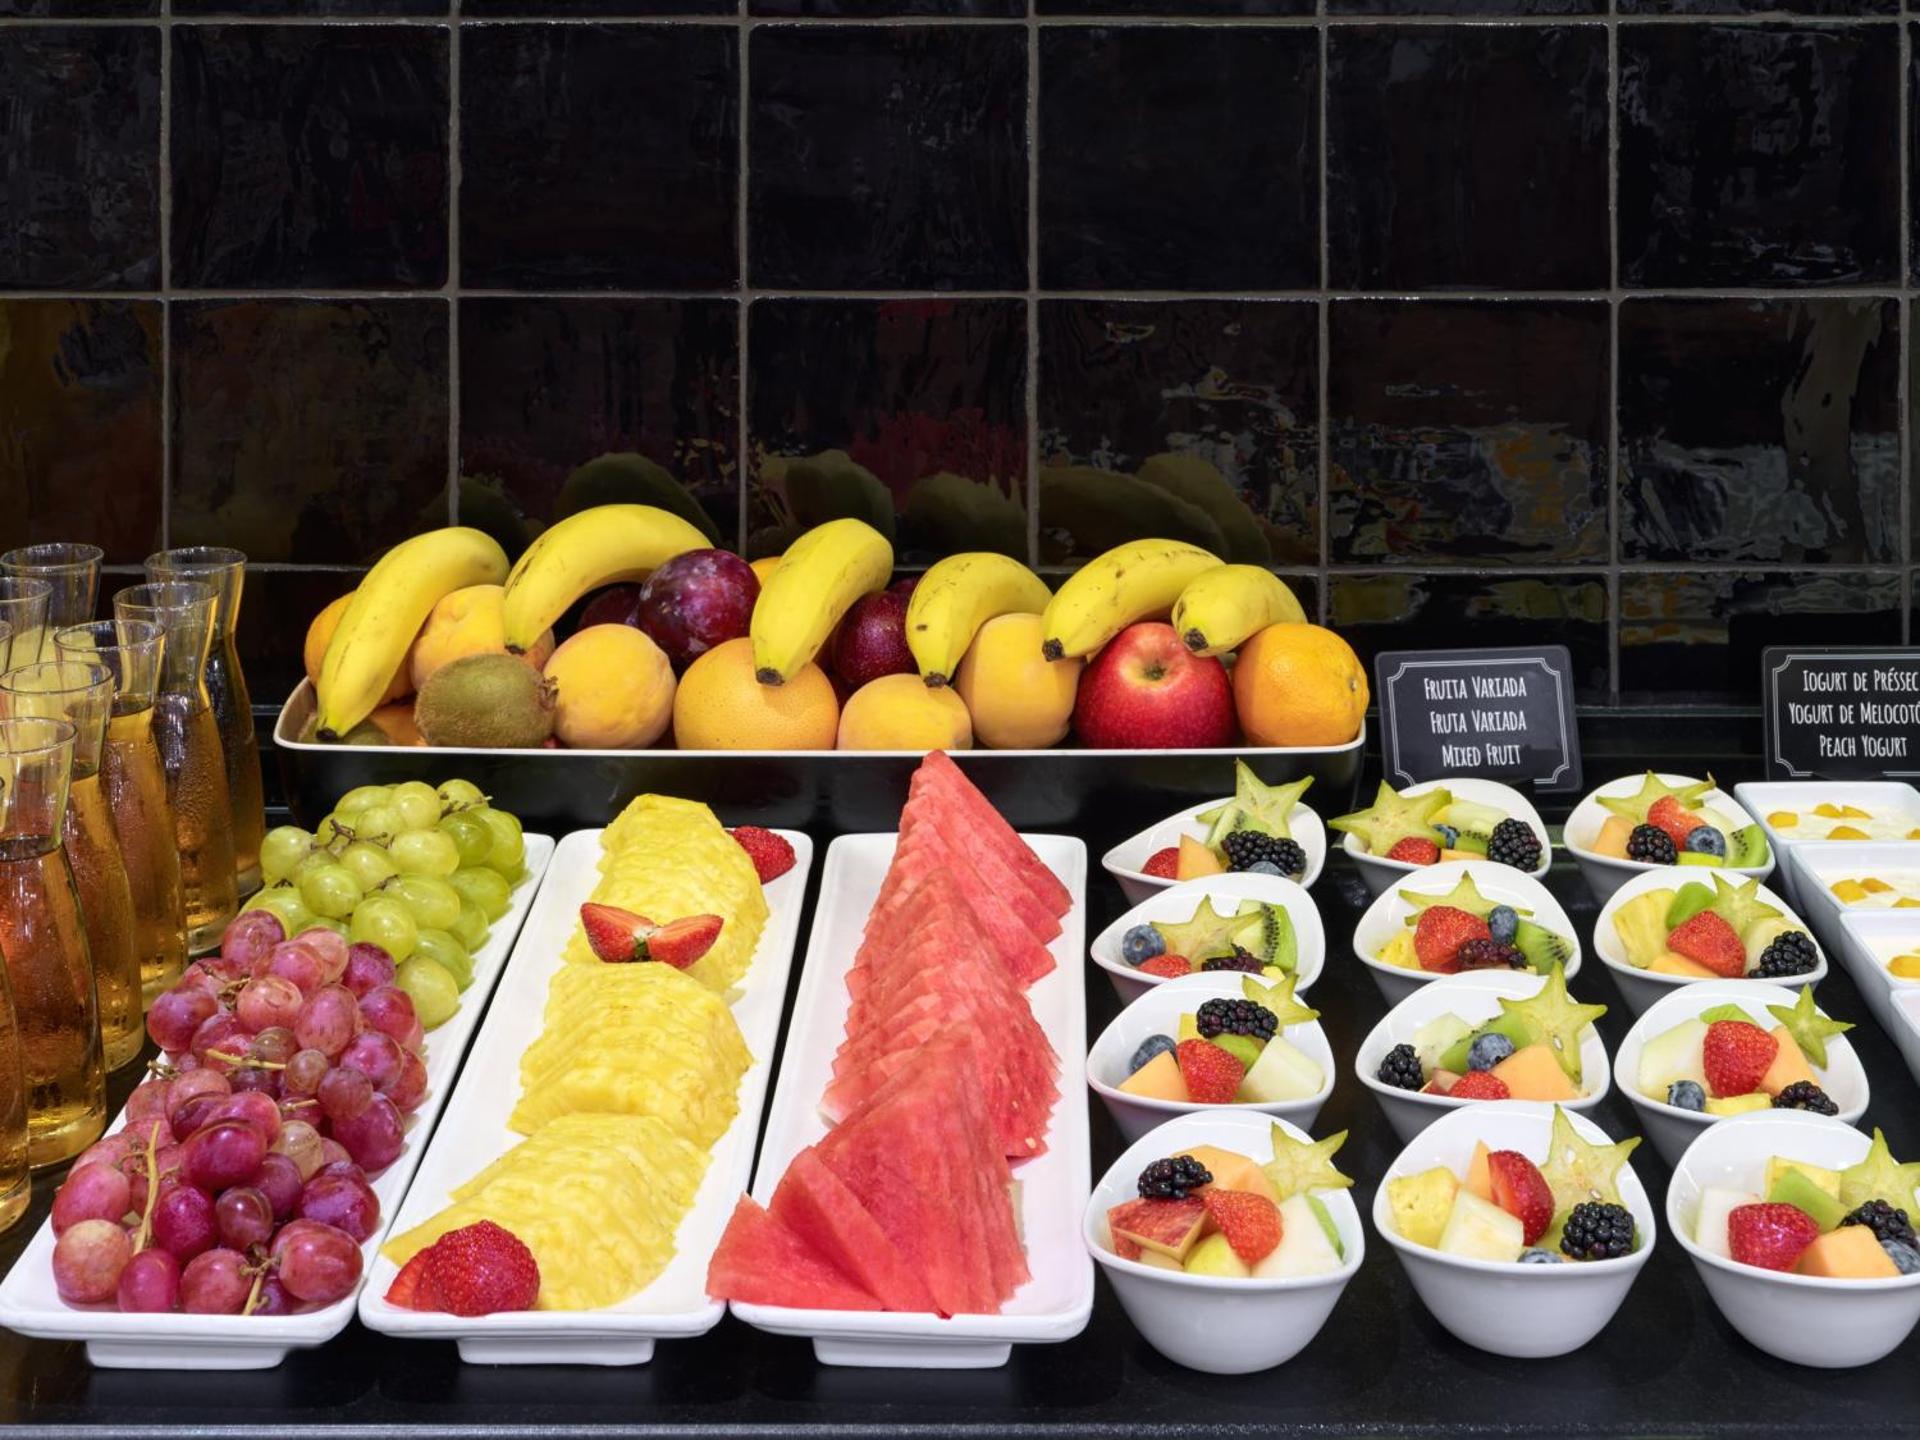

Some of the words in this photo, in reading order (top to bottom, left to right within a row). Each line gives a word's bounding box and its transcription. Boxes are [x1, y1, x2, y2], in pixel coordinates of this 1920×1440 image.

[1424, 677, 1468, 700] FRUITA
[1471, 676, 1527, 698] VARIADA
[1803, 670, 1848, 692] IOGURT
[1853, 672, 1868, 692] DE
[1430, 711, 1468, 734] FRUTA
[1471, 710, 1527, 732] VARIADA
[1788, 702, 1834, 725] YOGURT
[1839, 704, 1855, 725] DE
[1442, 745, 1481, 768] MIXED
[1486, 743, 1522, 766] FRUIT
[1819, 734, 1857, 757] PEACH
[1861, 734, 1907, 757] YOGURT
